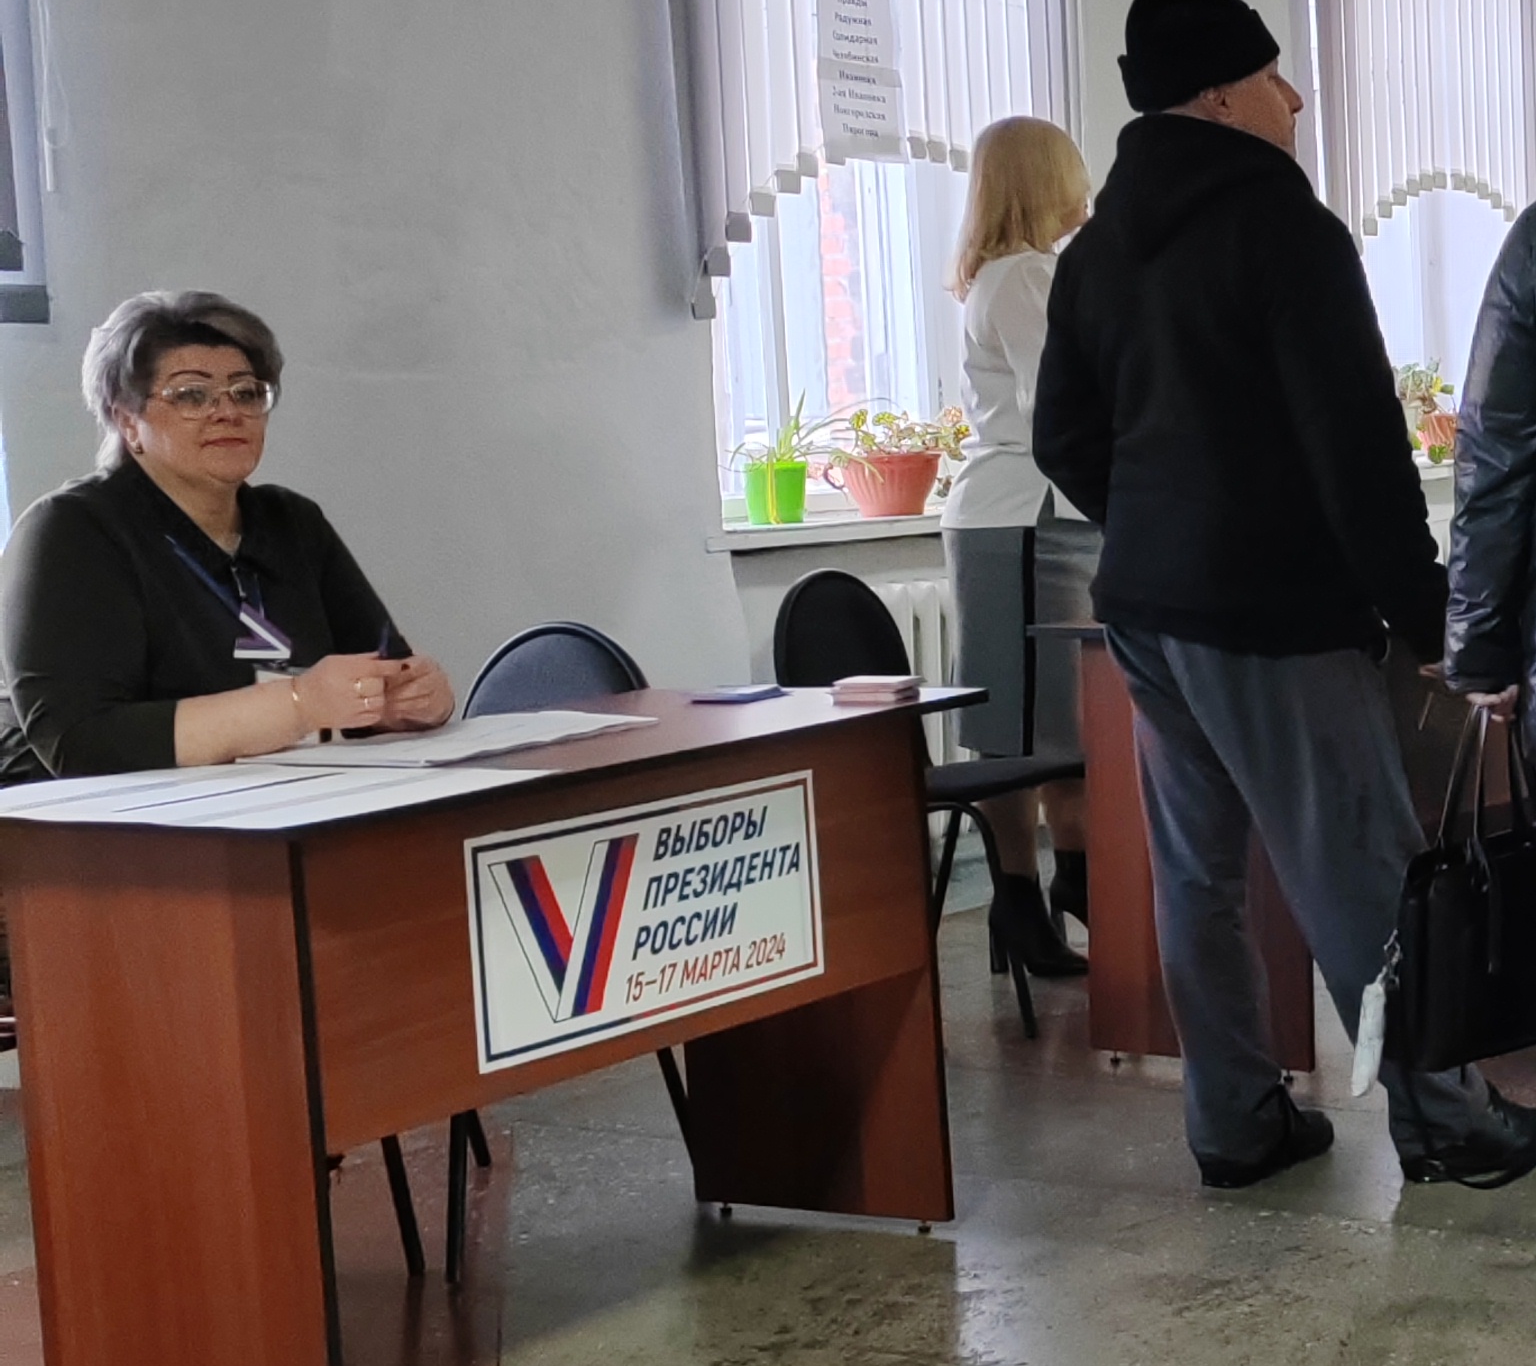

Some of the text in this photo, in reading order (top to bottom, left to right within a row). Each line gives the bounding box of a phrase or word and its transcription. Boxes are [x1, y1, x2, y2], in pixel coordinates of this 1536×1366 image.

[652, 805, 768, 862] ВЫБОРЫ
[642, 841, 801, 911] ПРЕЗИДЕНТА
[631, 901, 739, 961] РОССИИ
[679, 945, 742, 989] МАРТА
[744, 932, 786, 970] 2024
